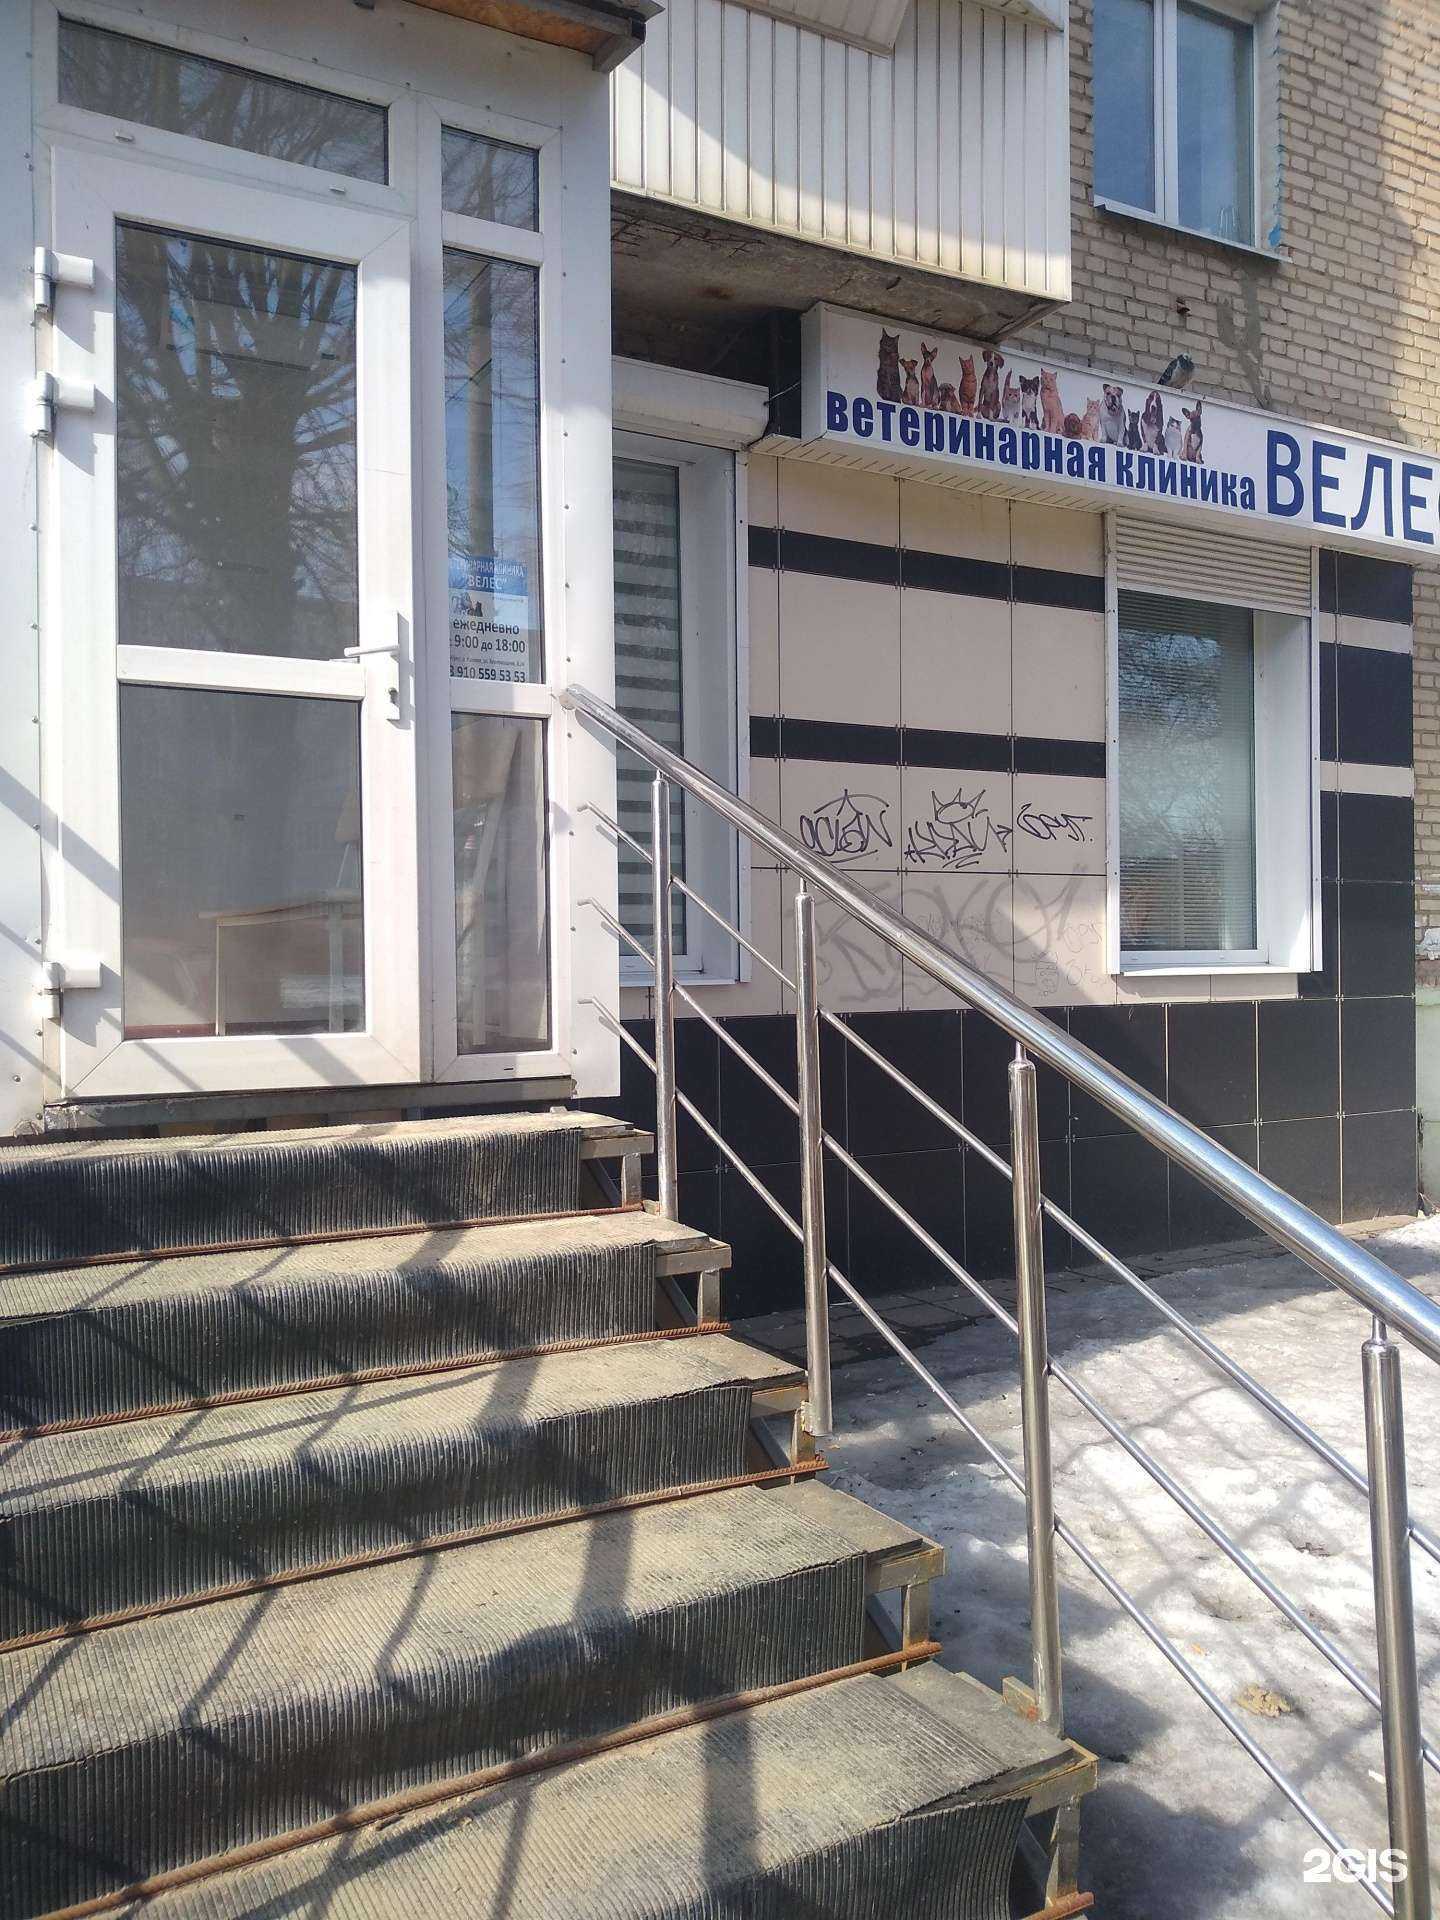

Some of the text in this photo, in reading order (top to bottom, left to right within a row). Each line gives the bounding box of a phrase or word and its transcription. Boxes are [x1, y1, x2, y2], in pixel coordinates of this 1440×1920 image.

[826, 390, 1440, 545] ветеринарная клиника ВЕЛЕ
[453, 619, 520, 635] ежедневно
[454, 634, 479, 649] 9:00
[481, 641, 493, 652] до
[495, 638, 526, 653] 18:00
[457, 666, 476, 679] 910
[478, 667, 497, 681] 559
[499, 669, 511, 682] 53
[513, 671, 526, 683] 53
